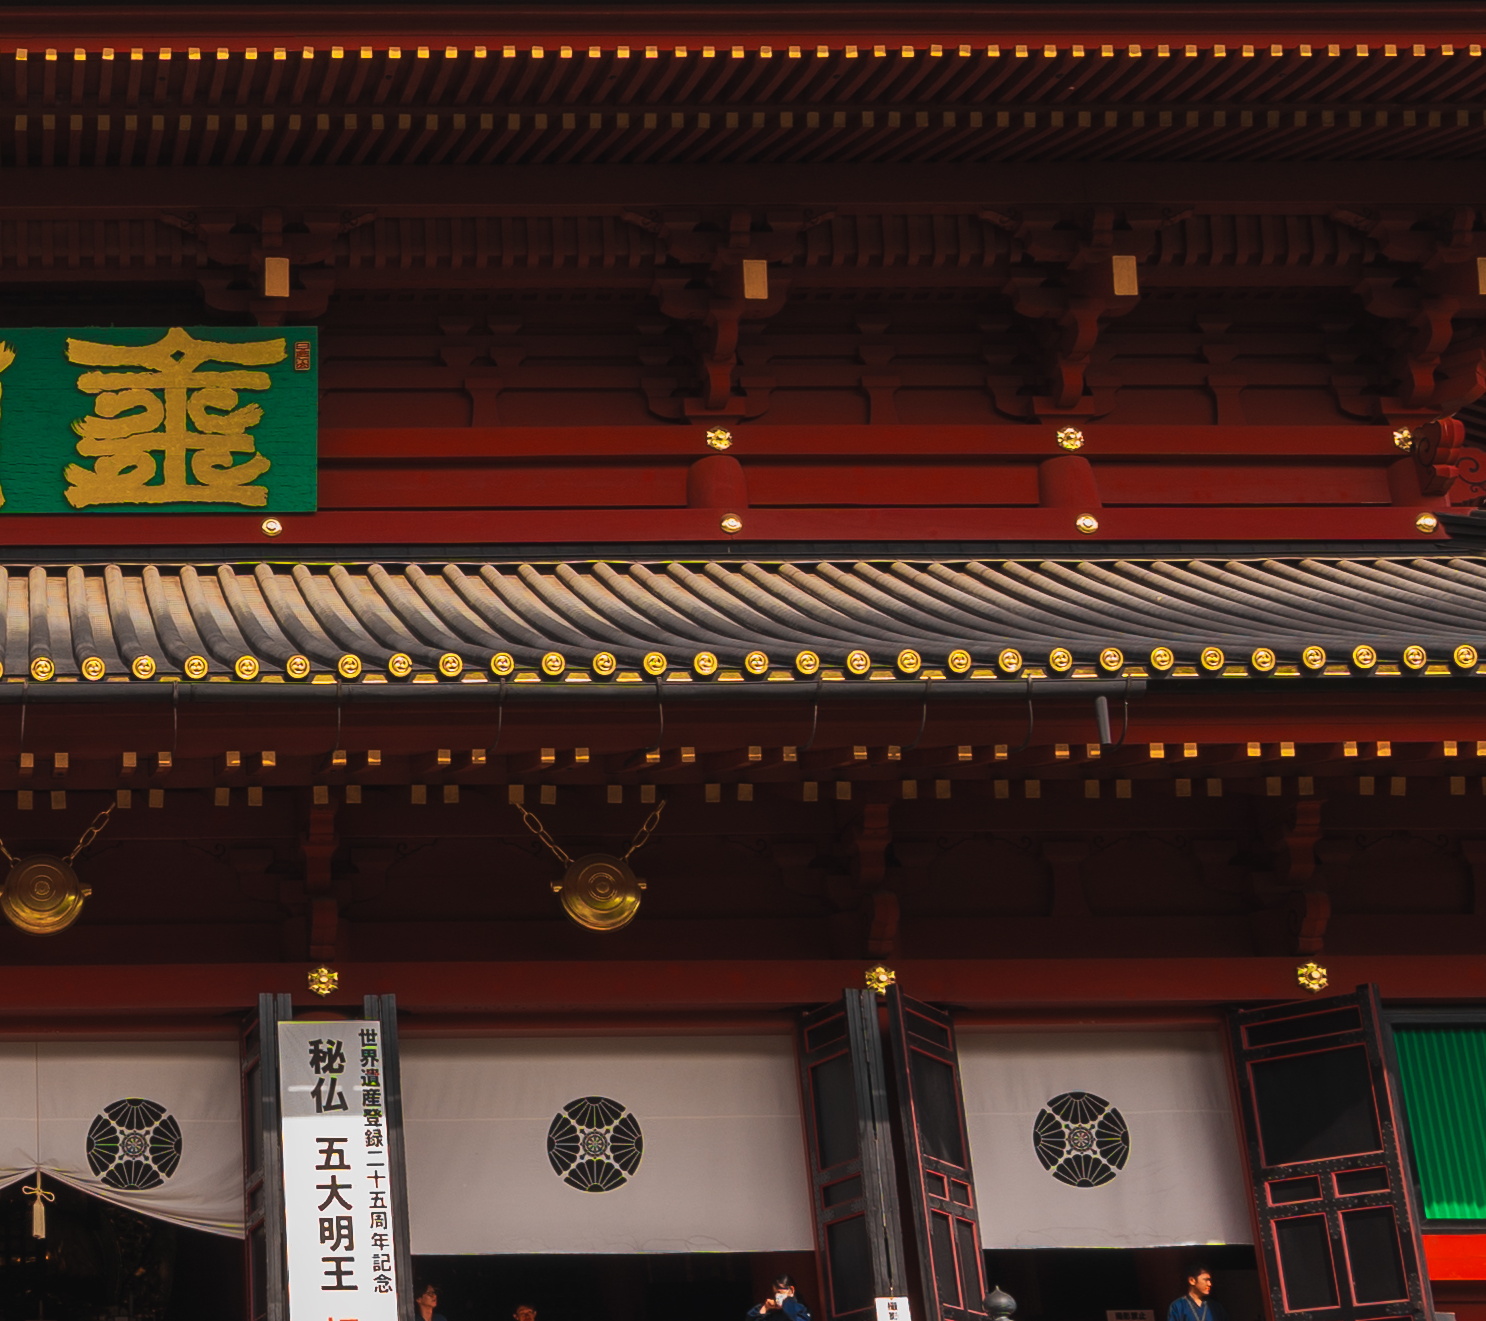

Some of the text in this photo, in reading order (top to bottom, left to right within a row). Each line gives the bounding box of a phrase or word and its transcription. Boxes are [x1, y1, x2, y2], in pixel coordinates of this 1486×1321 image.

[309, 1039, 348, 1113] 秘仏
[315, 1136, 358, 1293] 五大明王
[359, 1028, 393, 1294] 世界遺産登録二十五周年記念
